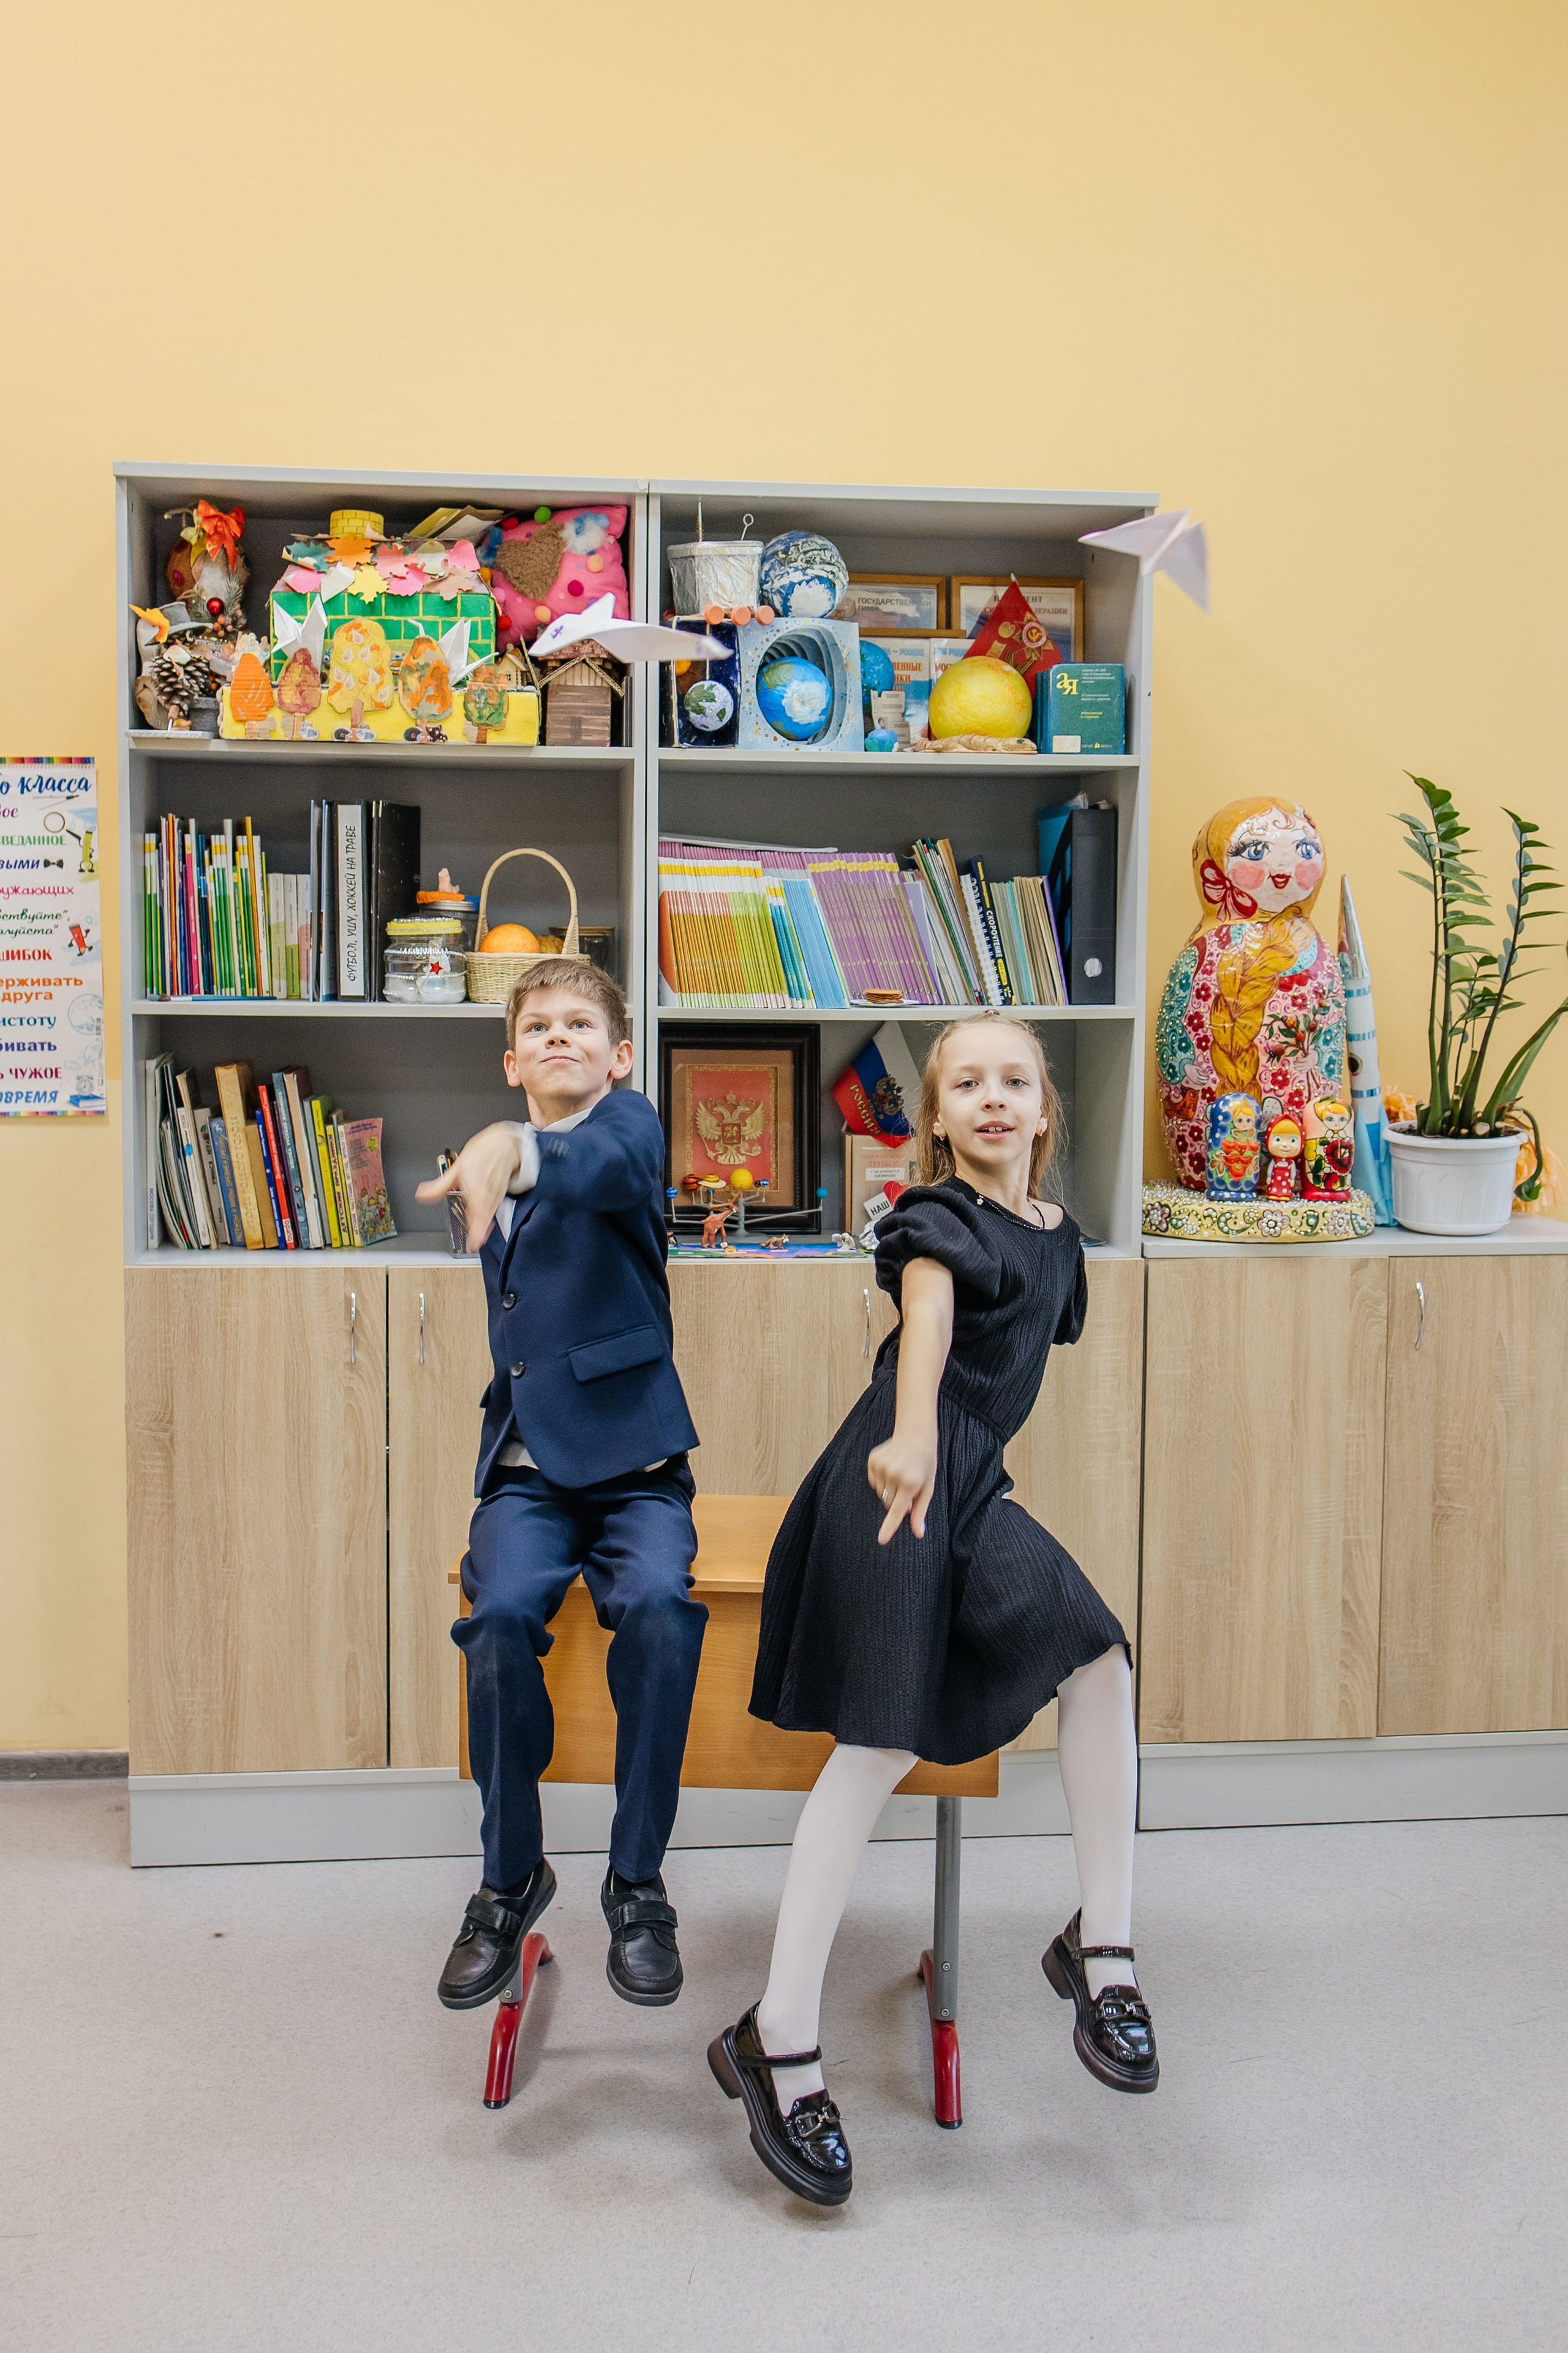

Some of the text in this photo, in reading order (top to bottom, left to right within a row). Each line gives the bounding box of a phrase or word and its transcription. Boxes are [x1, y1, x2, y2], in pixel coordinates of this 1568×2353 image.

[17, 775, 91, 794] класса
[0, 803, 18, 818] ое
[0, 835, 66, 846] ВЕДАННОЕ
[0, 885, 74, 900] ужающих
[345, 825, 357, 981] ФУТБОЛ, УШУ, ХОККЕЙ НА ТРАВЕ
[0, 908, 70, 923] ствуйте",
[986, 910, 1003, 957] СКОРОЧТЕНИЕ
[1, 991, 53, 1003] друга
[9, 1067, 62, 1079] ЧУЖОЕ
[850, 1084, 881, 1134] РОССИЯ
[870, 1201, 890, 1215] НАШ
